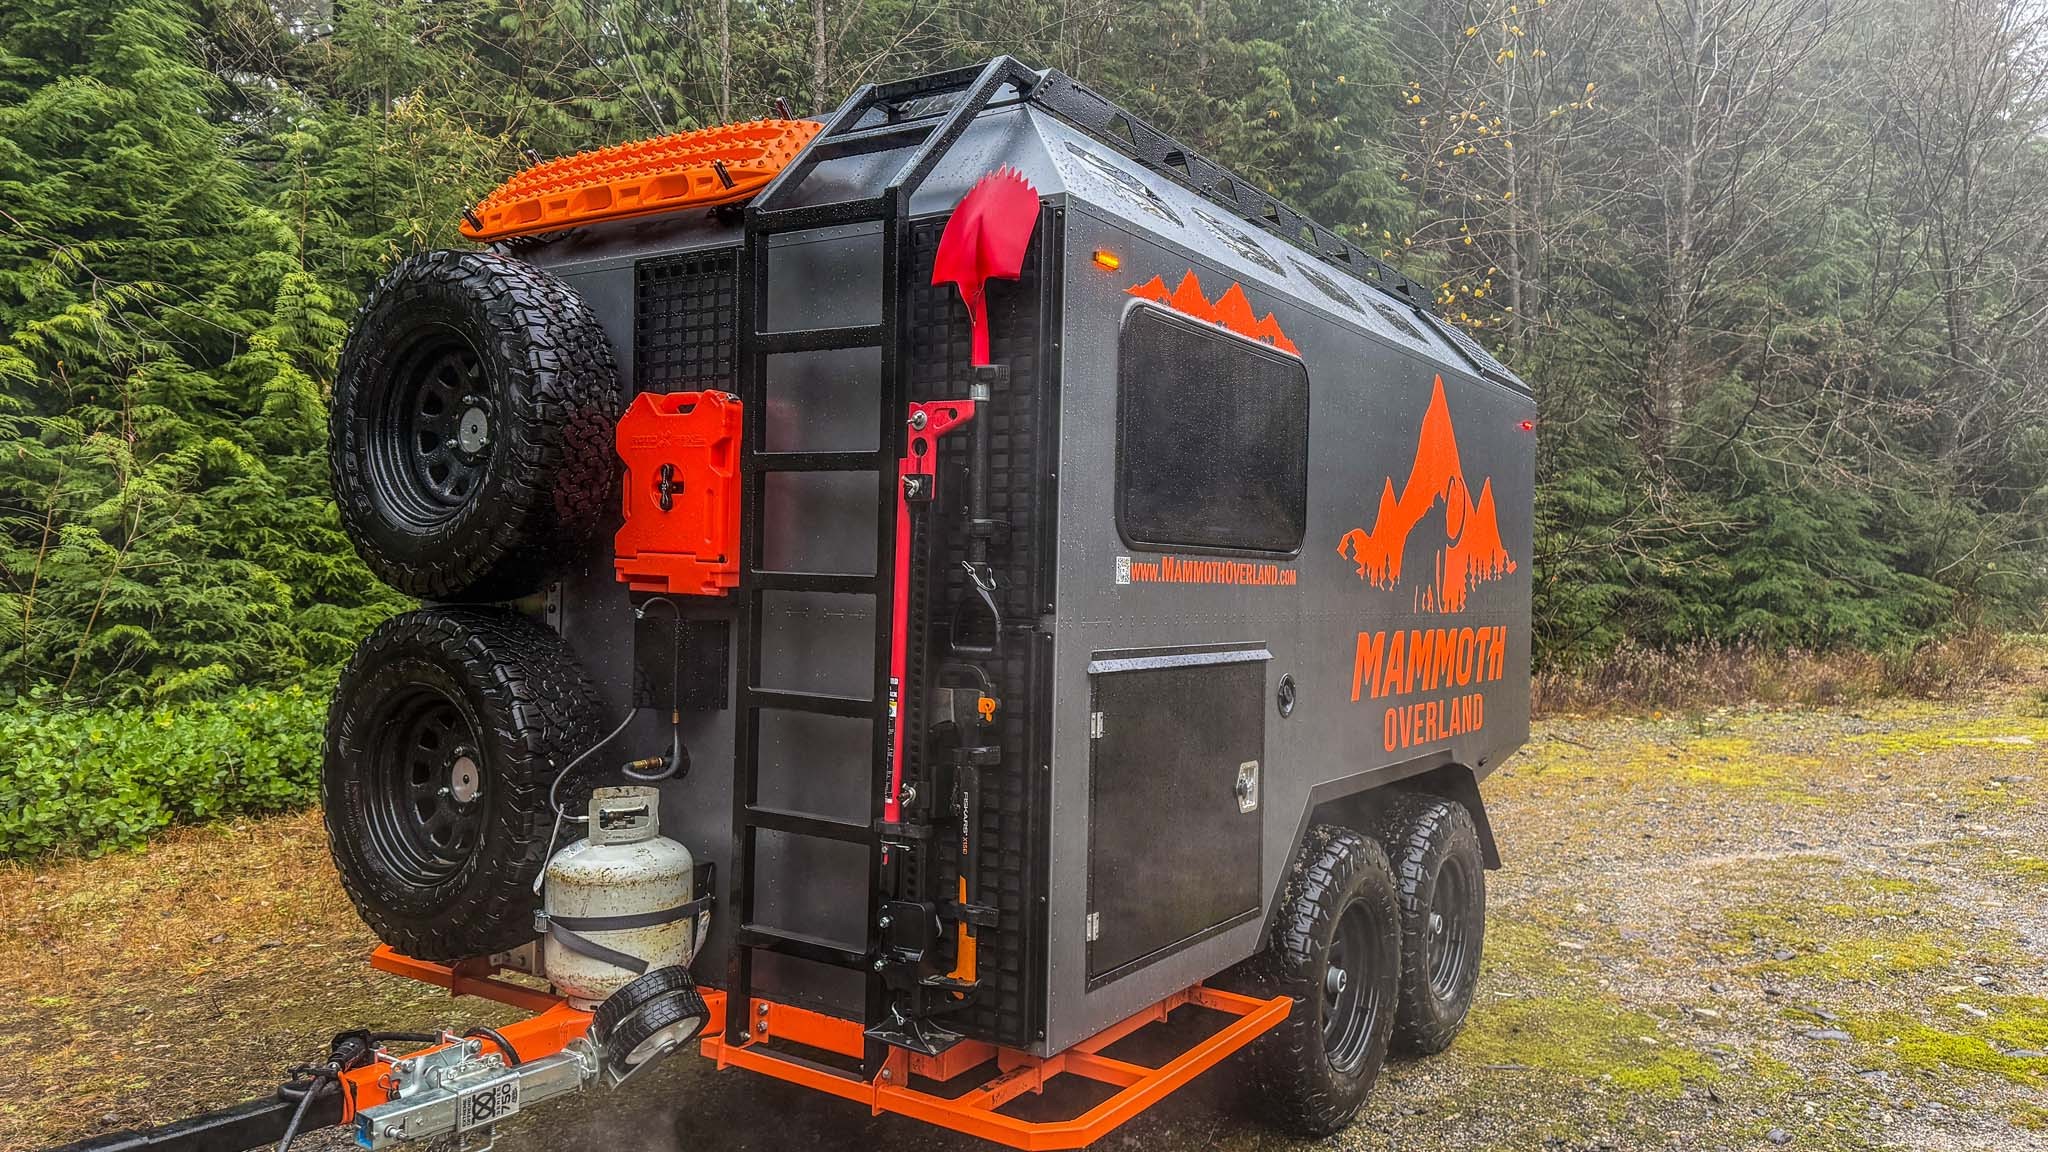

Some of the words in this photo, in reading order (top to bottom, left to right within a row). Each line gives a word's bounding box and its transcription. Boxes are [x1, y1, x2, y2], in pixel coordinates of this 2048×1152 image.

[1351, 625, 1507, 703] MAMMOTH
[1384, 693, 1484, 753] OVERLAND
[501, 1083, 511, 1115] 750
